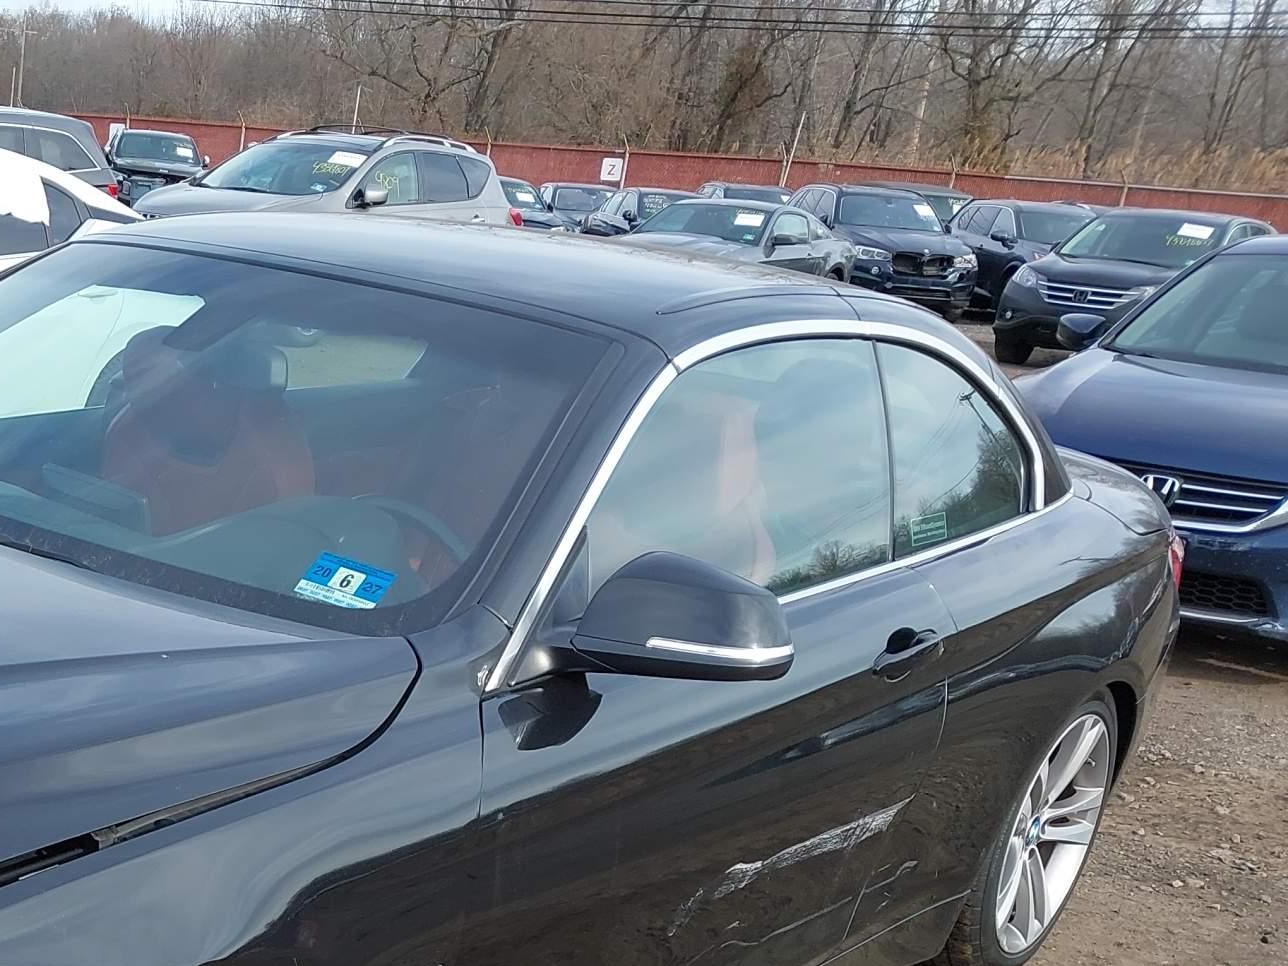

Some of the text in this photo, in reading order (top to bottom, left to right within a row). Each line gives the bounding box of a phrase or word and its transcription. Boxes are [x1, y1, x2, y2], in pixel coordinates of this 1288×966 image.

[607, 164, 617, 176] Z
[312, 565, 332, 578] 20
[339, 573, 355, 588] 6
[362, 582, 384, 594] 27
